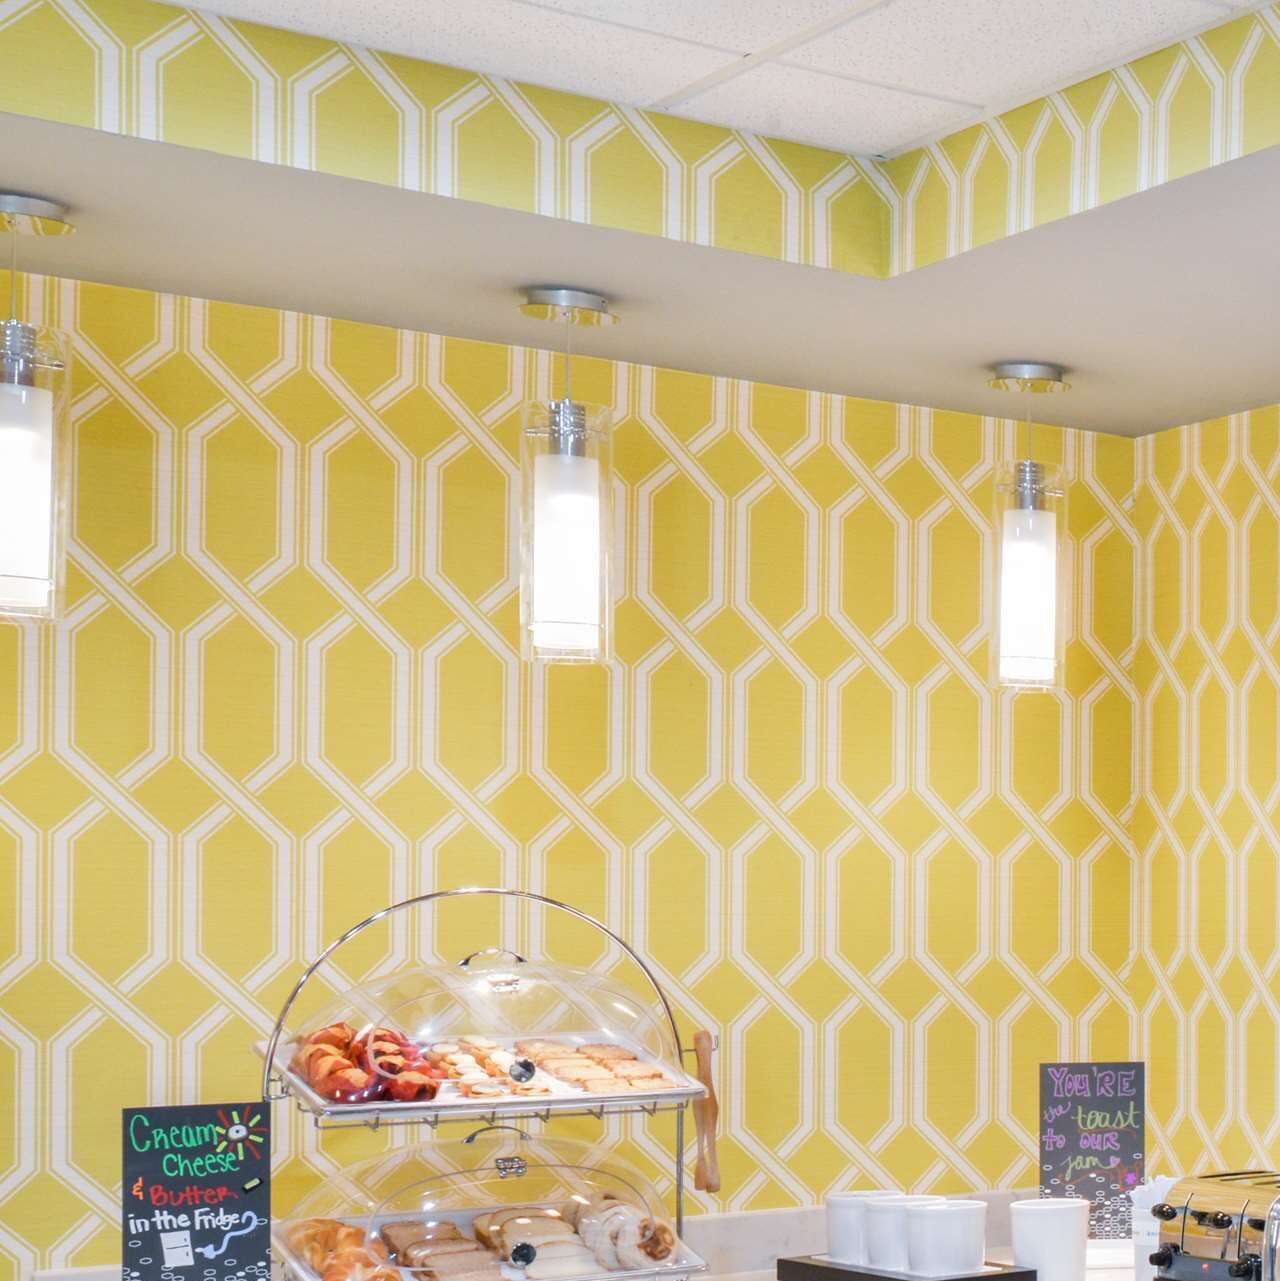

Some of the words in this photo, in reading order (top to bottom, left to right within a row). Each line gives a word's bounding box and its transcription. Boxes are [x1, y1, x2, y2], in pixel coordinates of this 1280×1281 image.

[1044, 1101, 1071, 1123] the
[1071, 1101, 1142, 1130] toast
[1042, 1128, 1066, 1151] to
[1060, 1154, 1107, 1181] jam
[128, 1213, 150, 1234] in
[151, 1209, 191, 1230] the
[193, 1207, 240, 1231] Fridge
